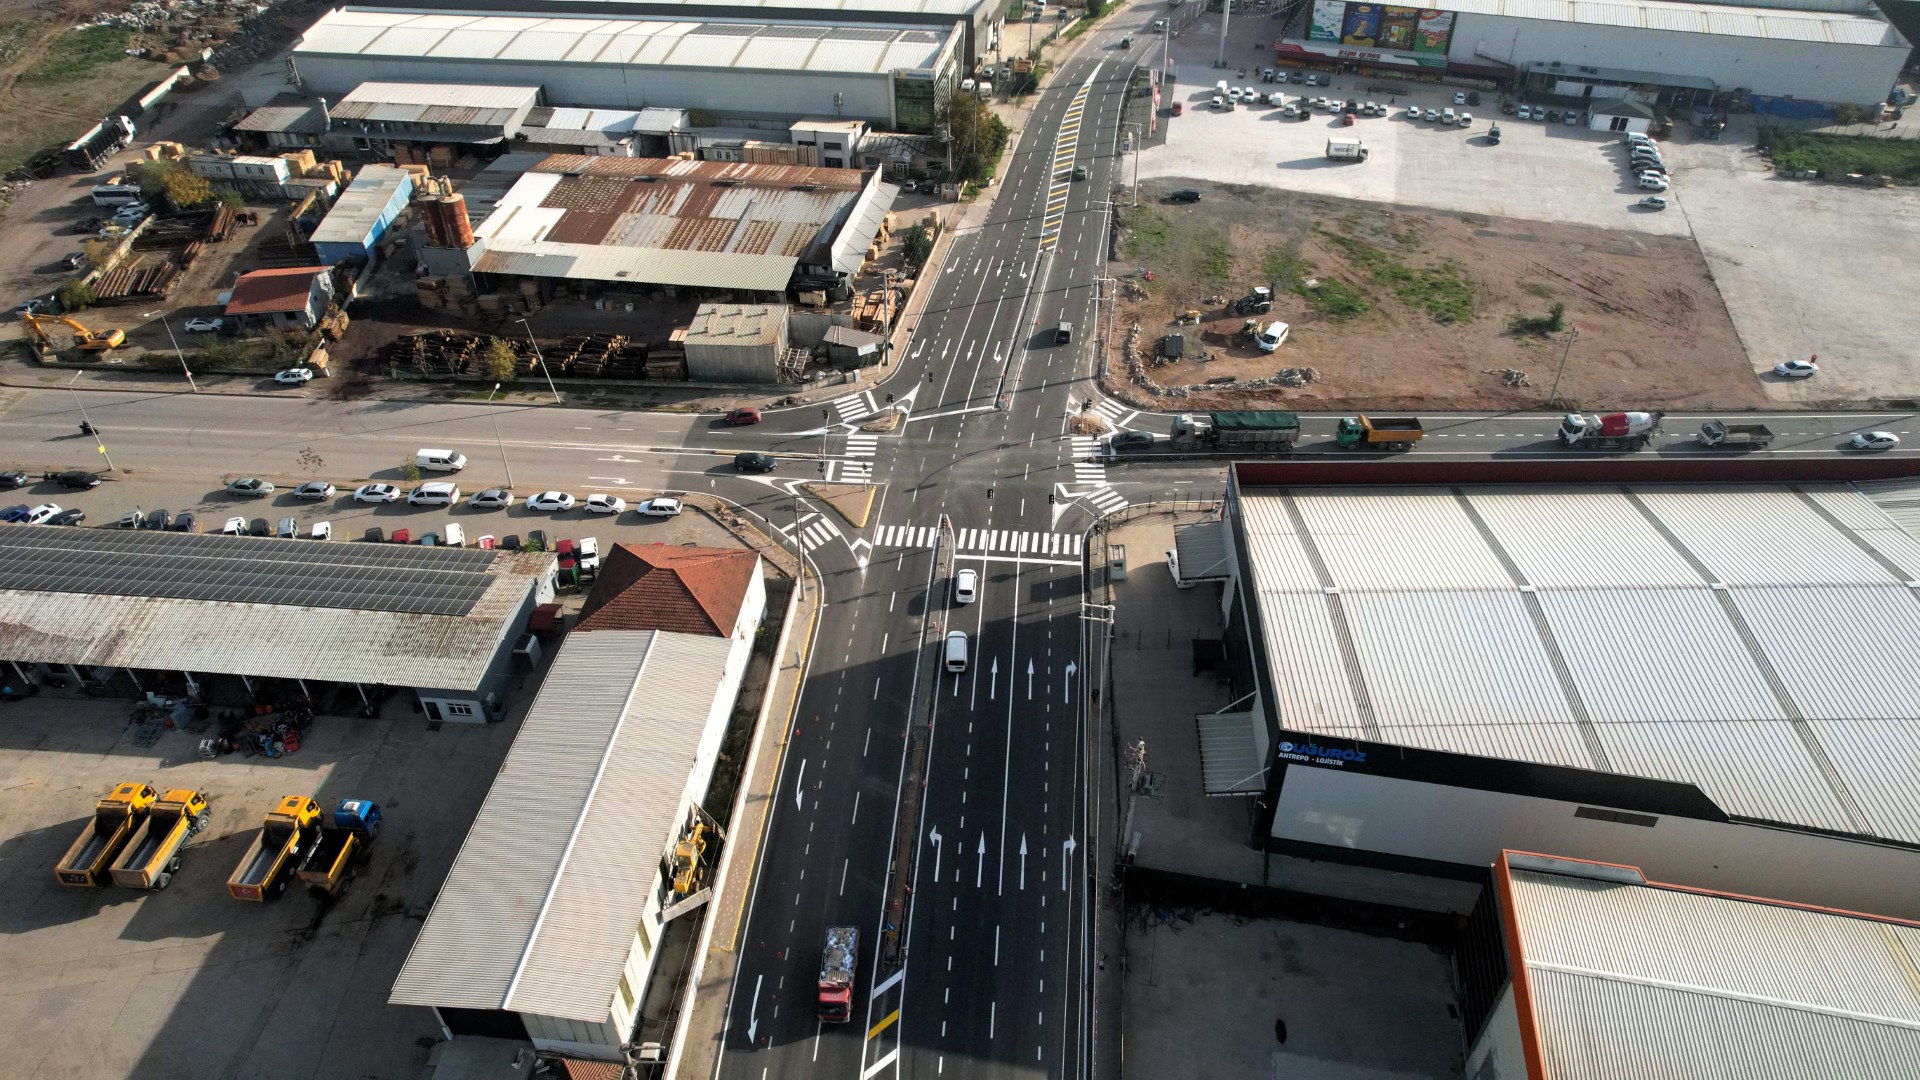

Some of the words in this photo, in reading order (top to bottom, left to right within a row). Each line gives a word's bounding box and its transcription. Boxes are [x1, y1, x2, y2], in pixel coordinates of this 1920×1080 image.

[1278, 752, 1309, 762] ANTREPO
[1316, 757, 1344, 766] LOJİSTİK
[1293, 743, 1367, 762] UĞURÖZ
